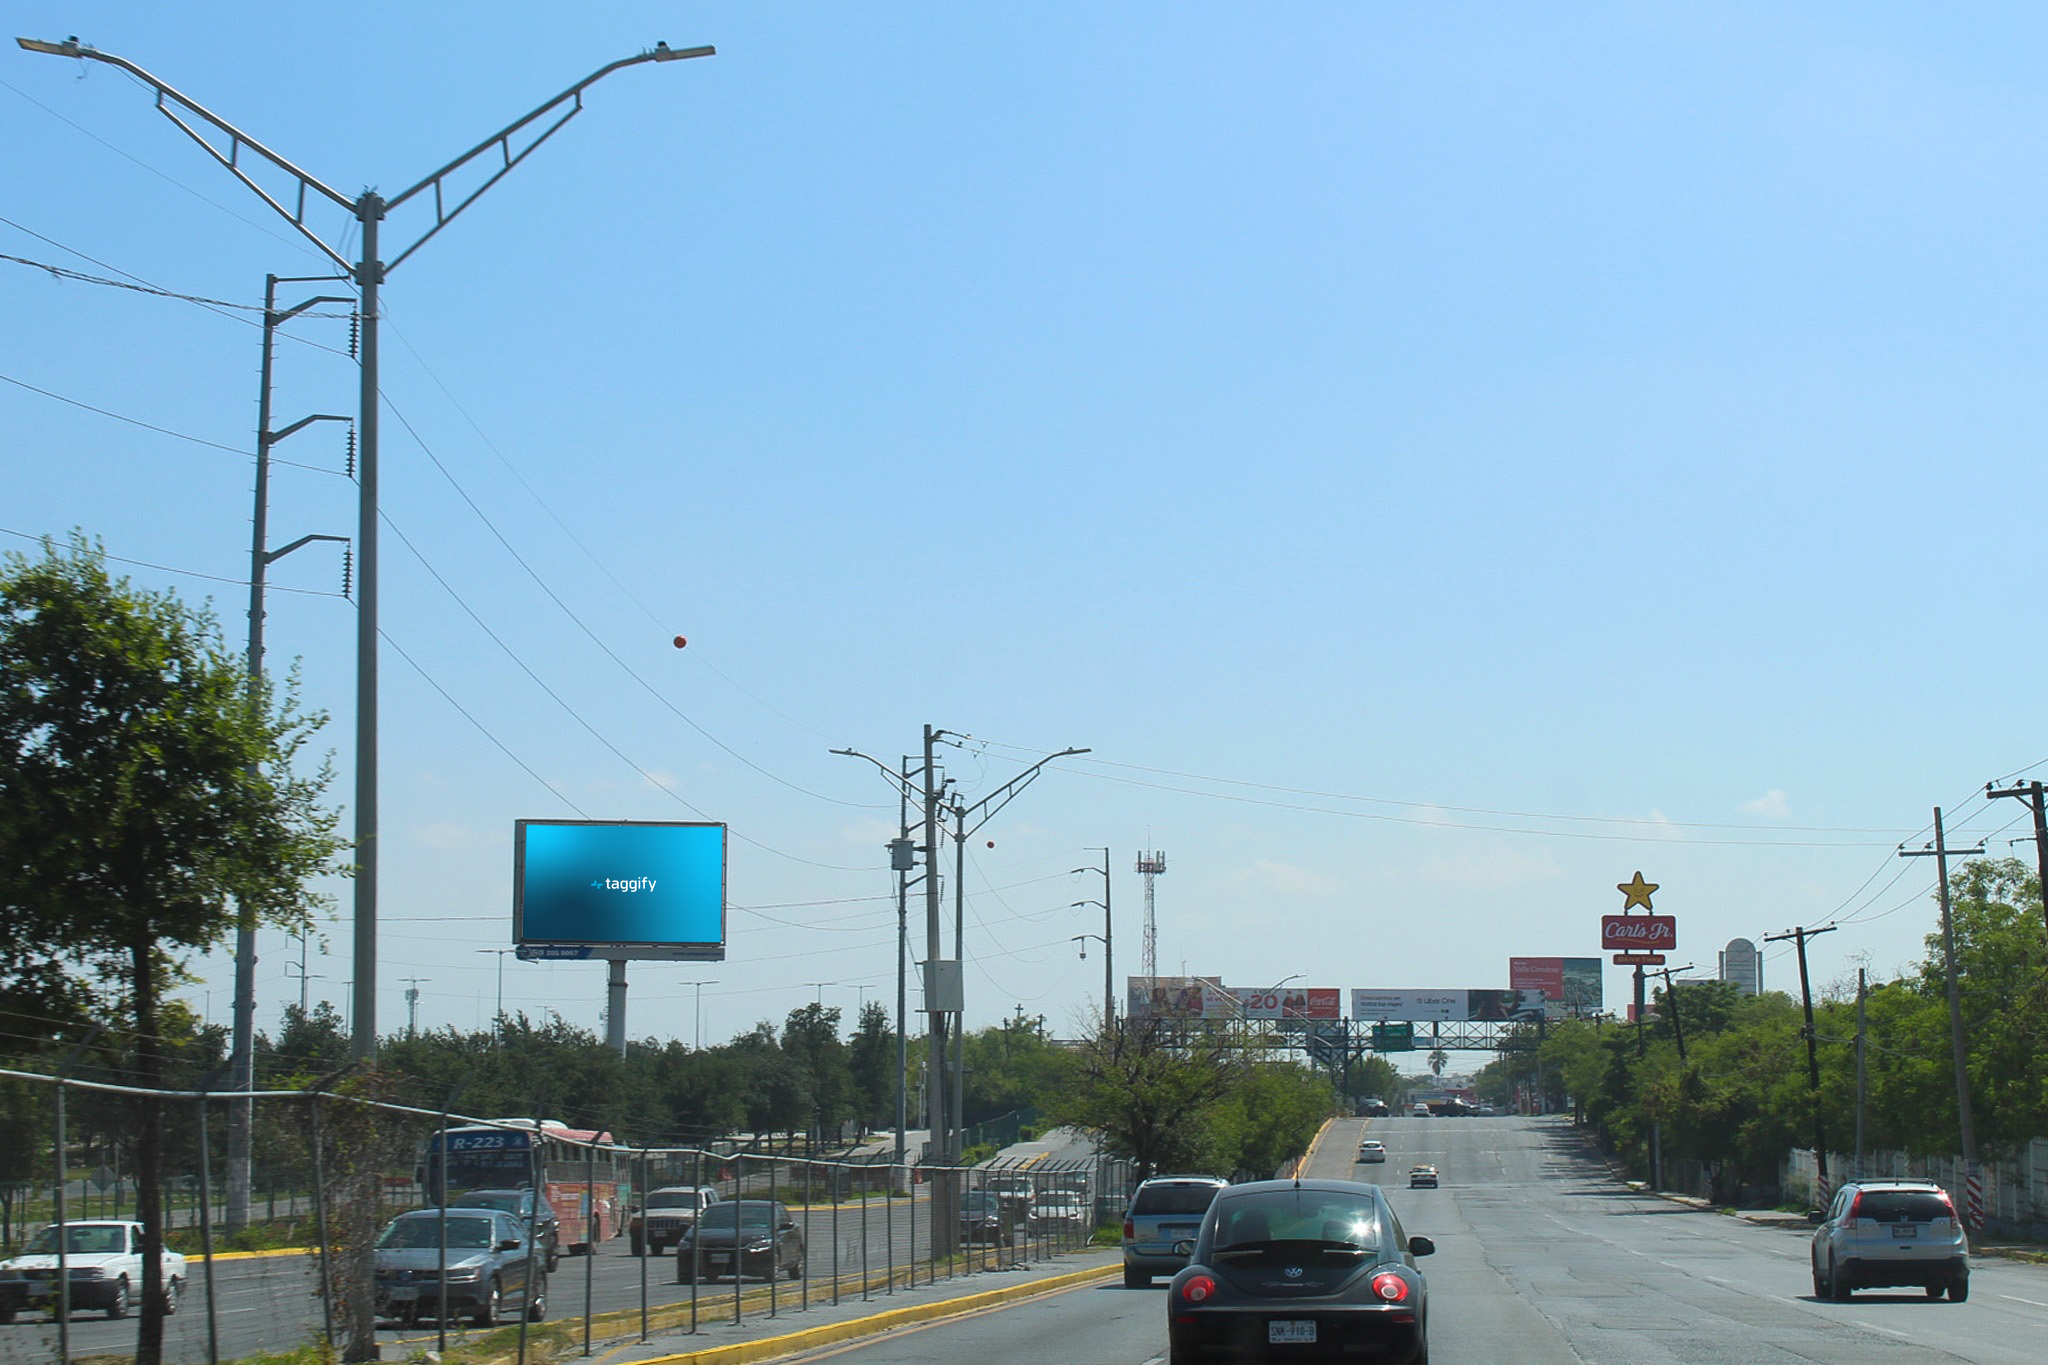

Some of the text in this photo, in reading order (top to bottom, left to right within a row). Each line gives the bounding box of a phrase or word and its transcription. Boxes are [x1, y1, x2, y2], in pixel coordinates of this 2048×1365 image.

[605, 876, 657, 892] taggify
[1605, 922, 1647, 938] Carl's
[453, 1136, 505, 1150] R-223
